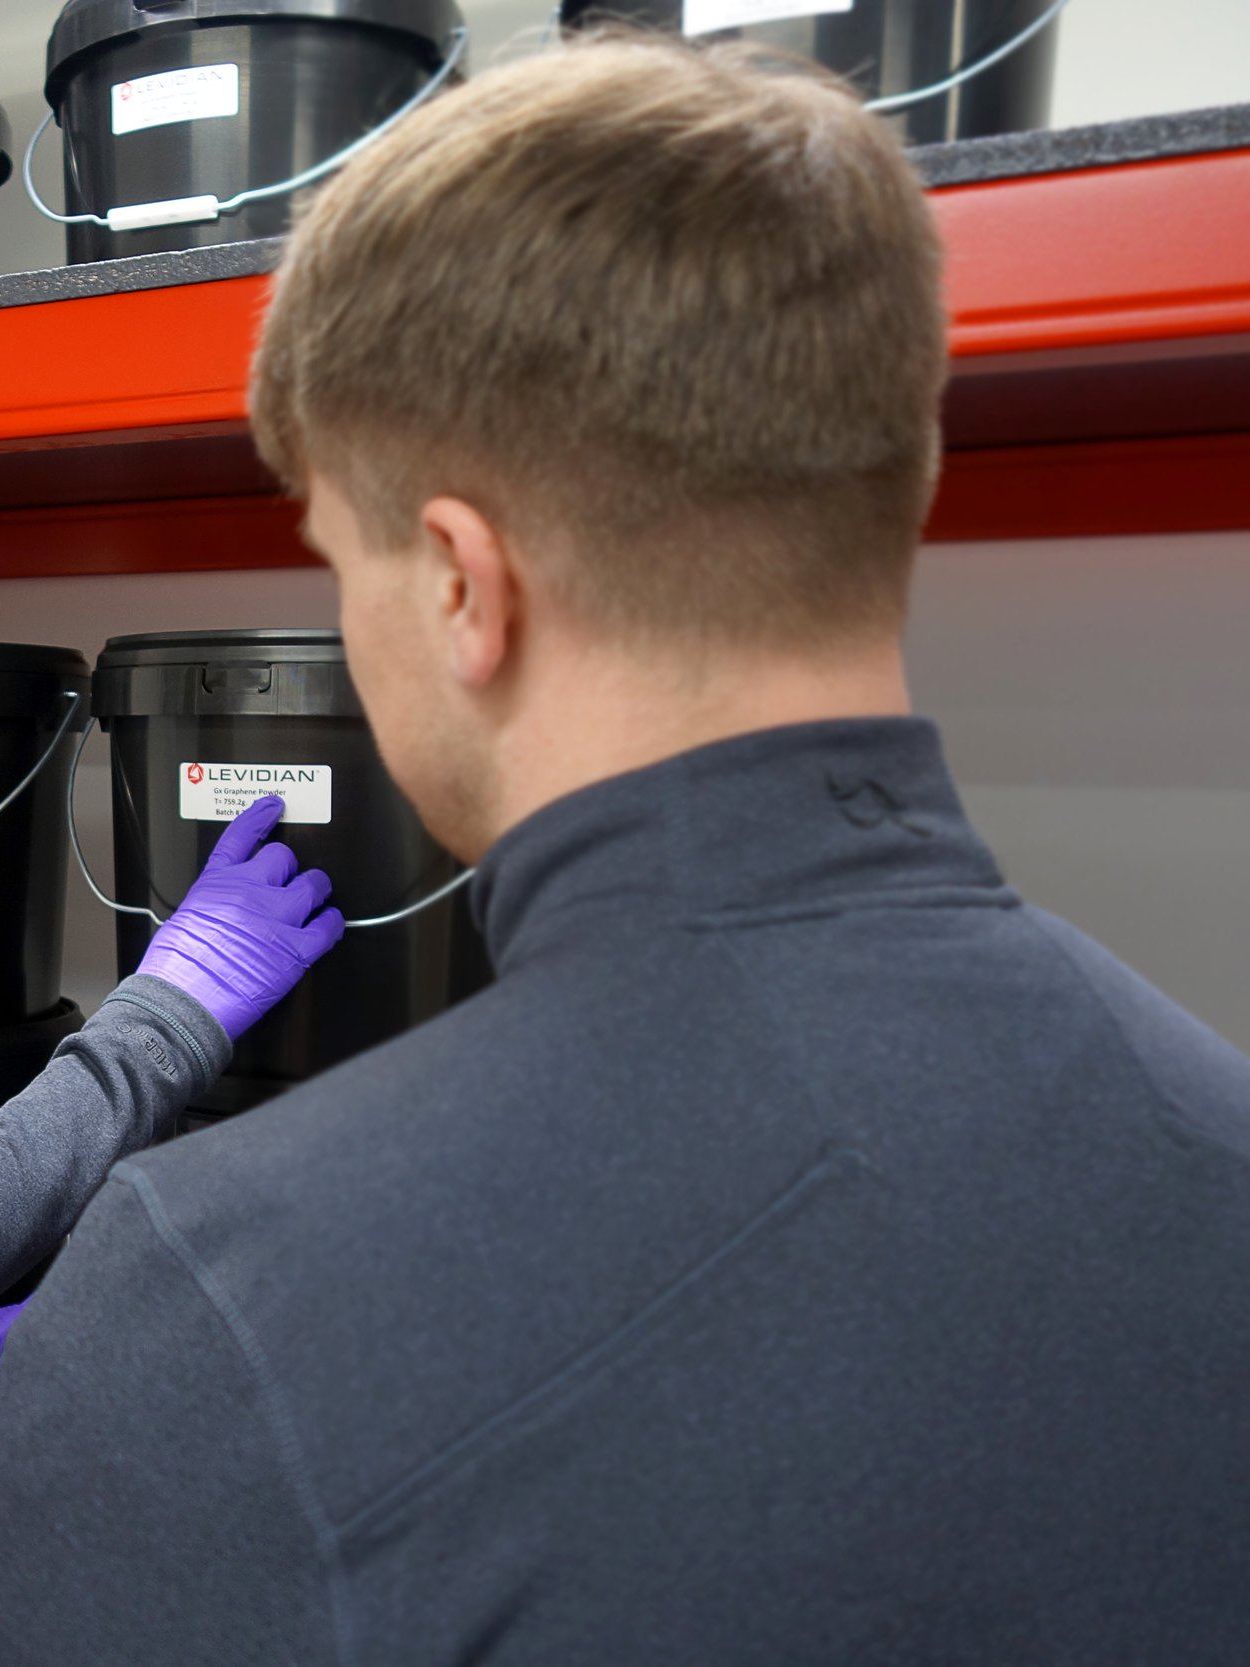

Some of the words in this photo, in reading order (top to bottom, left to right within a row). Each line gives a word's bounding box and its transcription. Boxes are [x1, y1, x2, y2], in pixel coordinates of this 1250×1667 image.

[138, 71, 224, 93] LEVIDIAN
[209, 768, 314, 782] LEVIDIAN
[224, 788, 256, 796] Graphene
[258, 788, 286, 796] Powder
